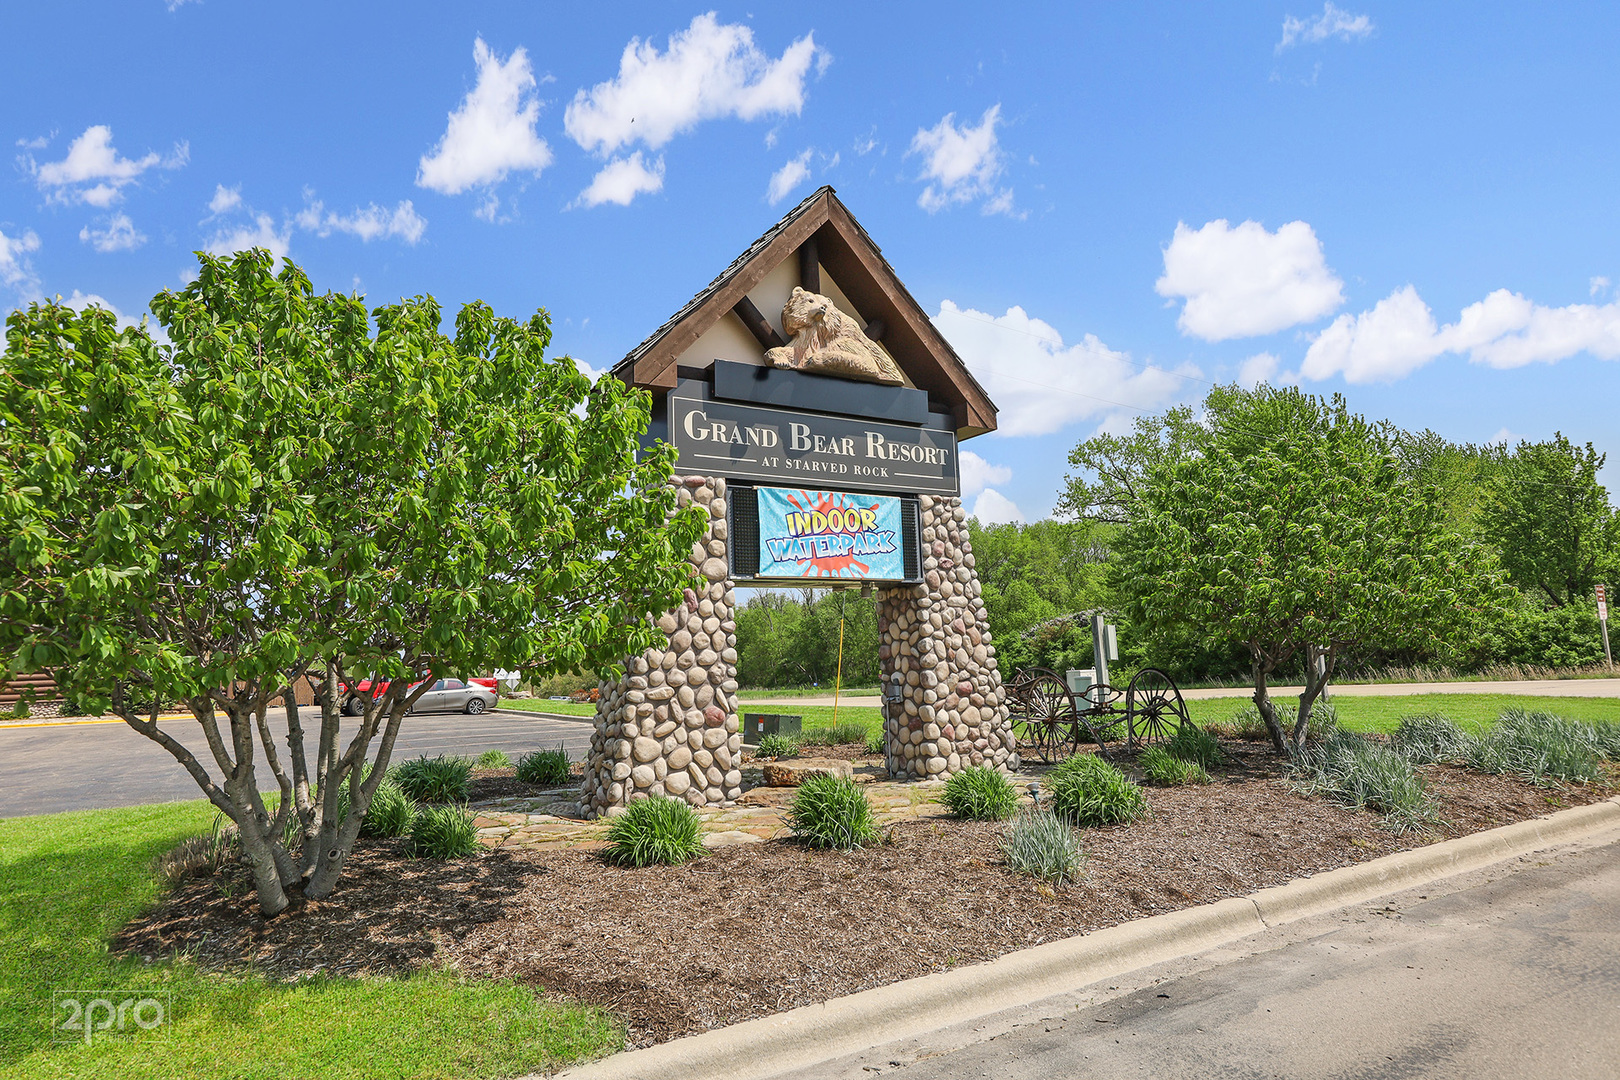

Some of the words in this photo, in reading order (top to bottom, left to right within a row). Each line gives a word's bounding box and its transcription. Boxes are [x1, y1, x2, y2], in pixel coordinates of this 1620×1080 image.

[683, 410, 778, 448] GRAND
[789, 422, 856, 457] BEAR
[864, 431, 949, 466] RESORT
[761, 456, 779, 468] AT
[785, 458, 848, 474] STARVED
[853, 465, 889, 478] ROCK
[785, 508, 879, 537] INDOOR
[766, 531, 897, 563] WATERPARK
